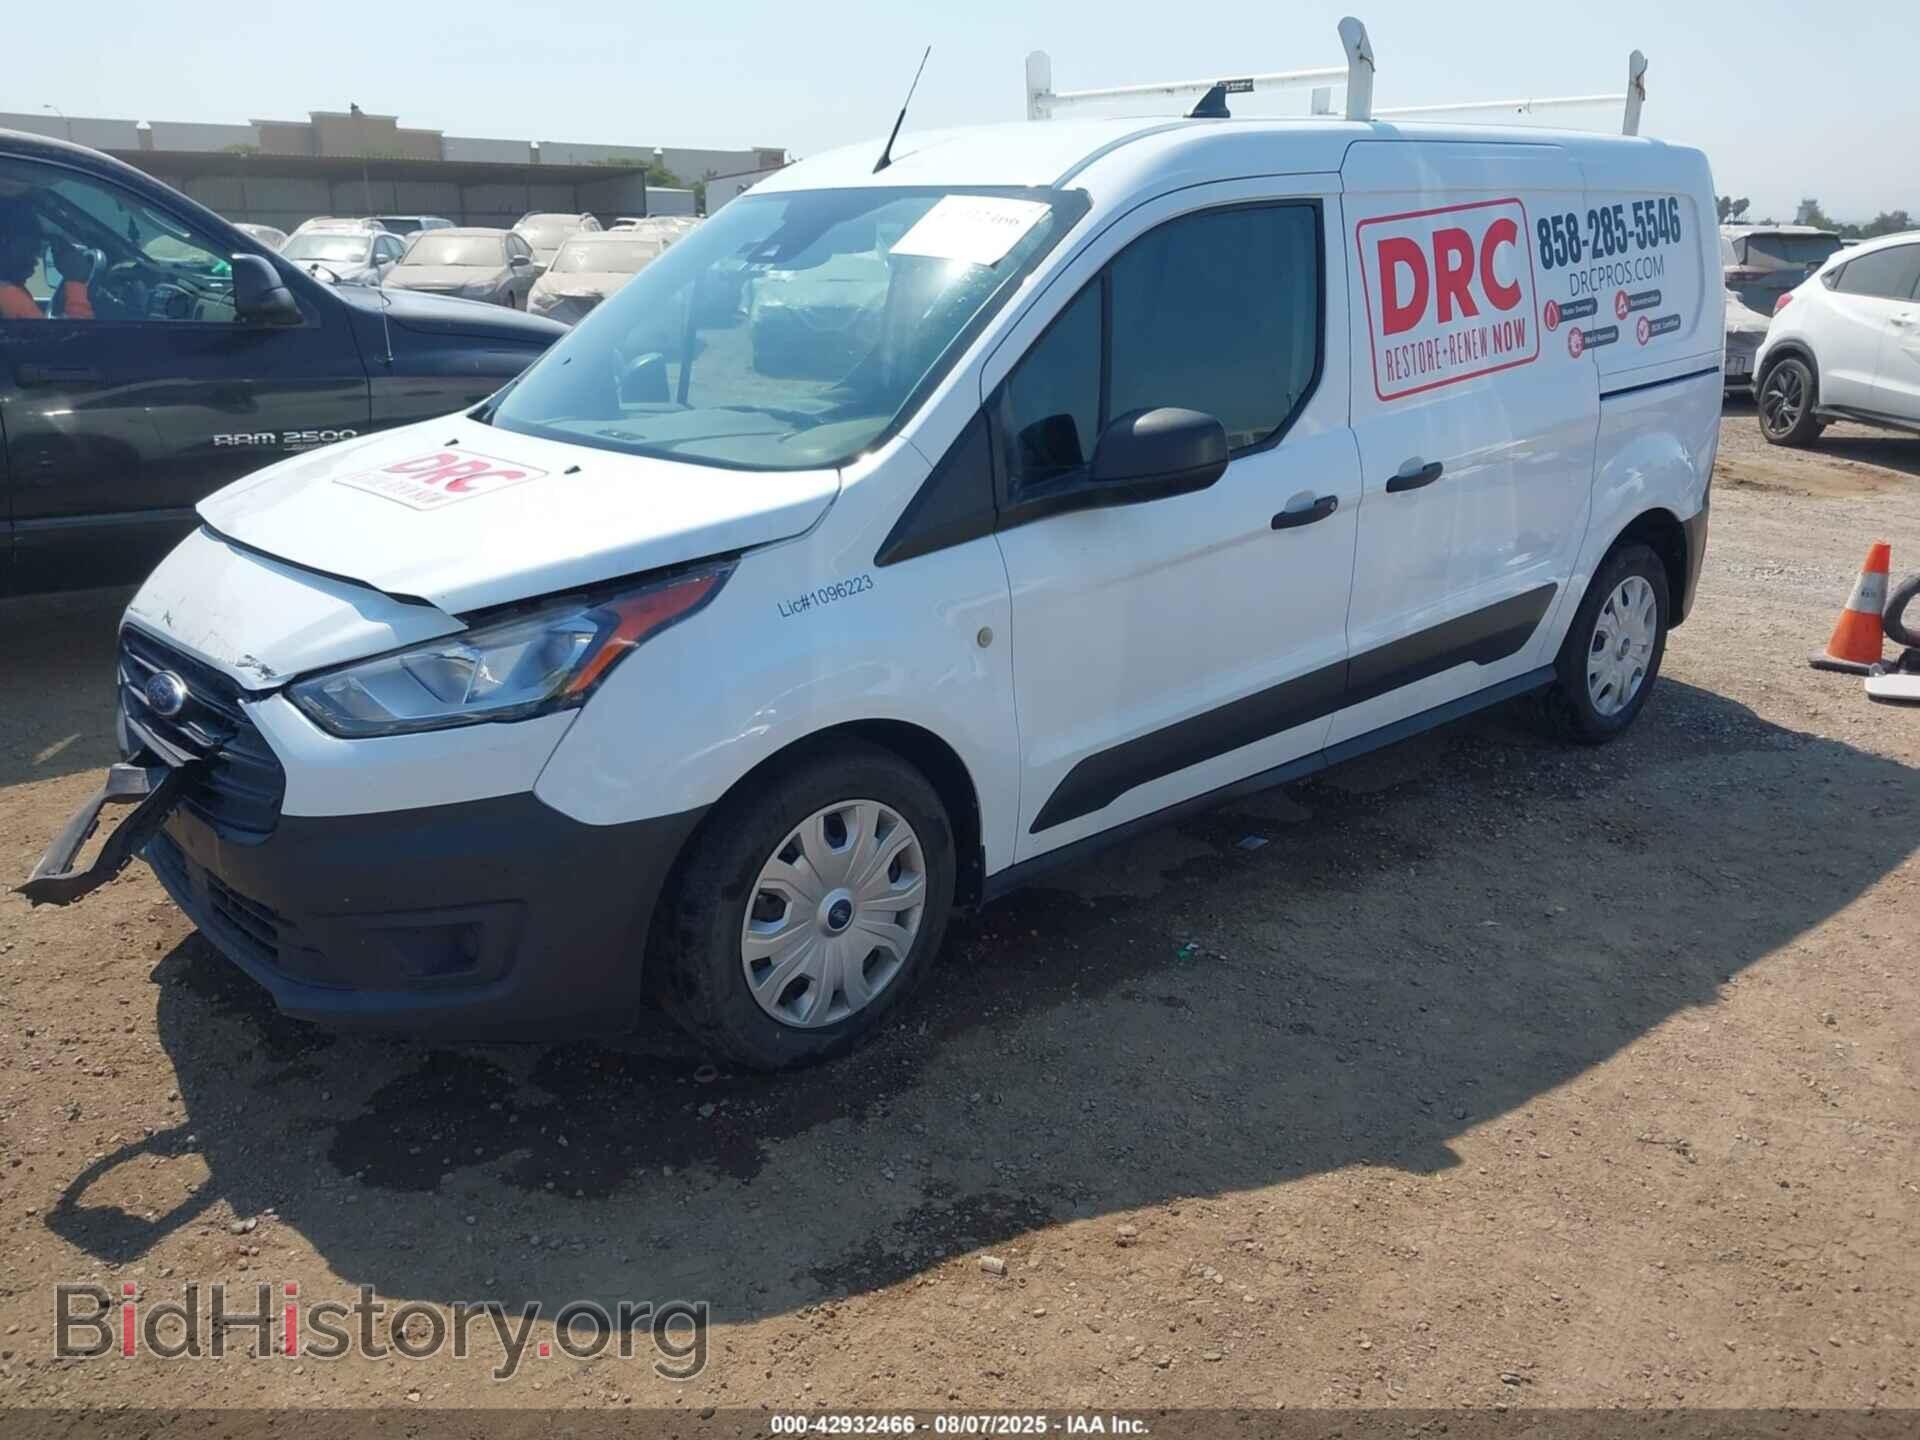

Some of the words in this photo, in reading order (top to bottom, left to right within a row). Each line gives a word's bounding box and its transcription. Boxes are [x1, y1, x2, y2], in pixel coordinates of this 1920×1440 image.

[1537, 197, 1681, 270] 858-285-5546
[1376, 218, 1523, 336] DRC
[1569, 254, 1665, 297] DRCPROS.COM
[1492, 317, 1526, 354] NOW
[213, 432, 276, 446] RAM
[282, 429, 358, 444] 2500
[382, 453, 527, 492] DRC
[777, 574, 874, 618] Lic#1096223
